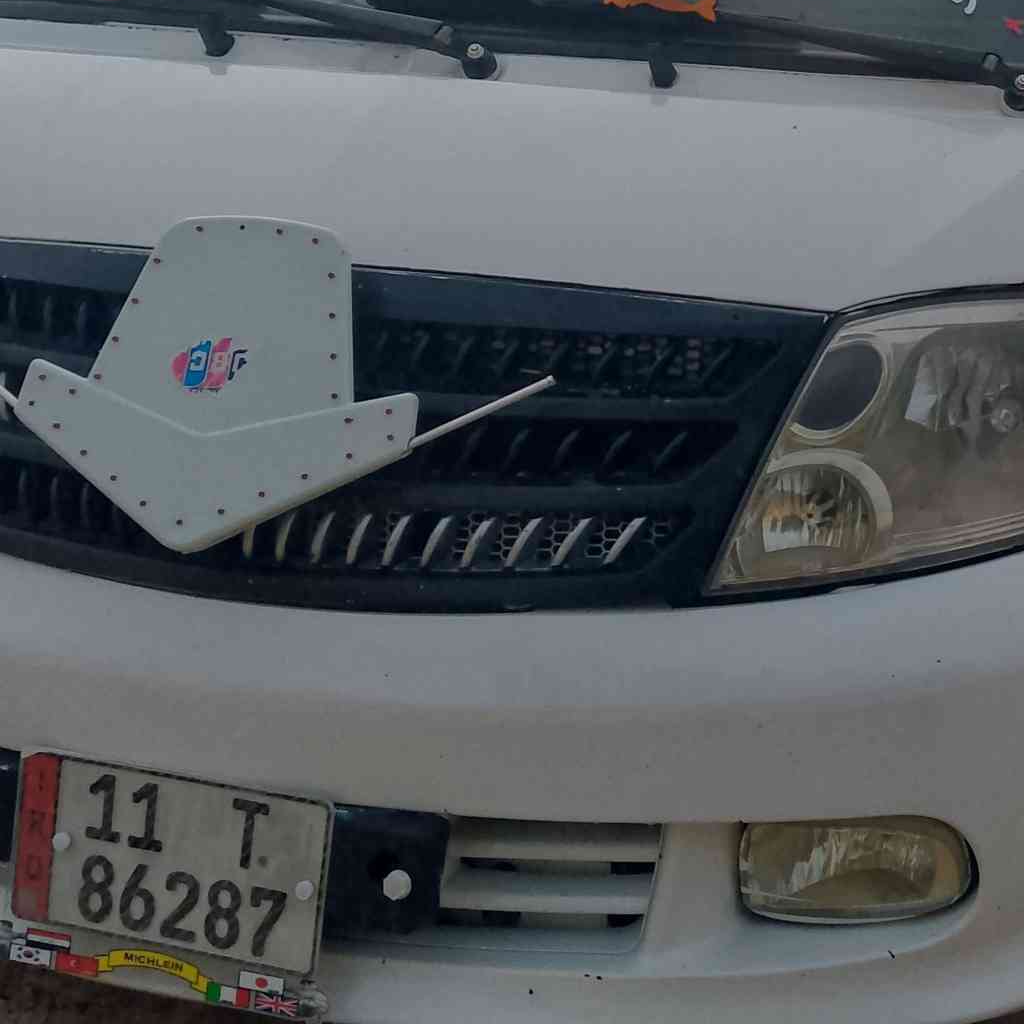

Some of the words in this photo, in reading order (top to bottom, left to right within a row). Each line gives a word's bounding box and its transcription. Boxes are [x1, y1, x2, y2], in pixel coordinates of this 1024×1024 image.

[84, 774, 164, 853] 11
[231, 796, 272, 870] T
[77, 854, 288, 958] 86287
[123, 952, 184, 972] MICHLEIN
